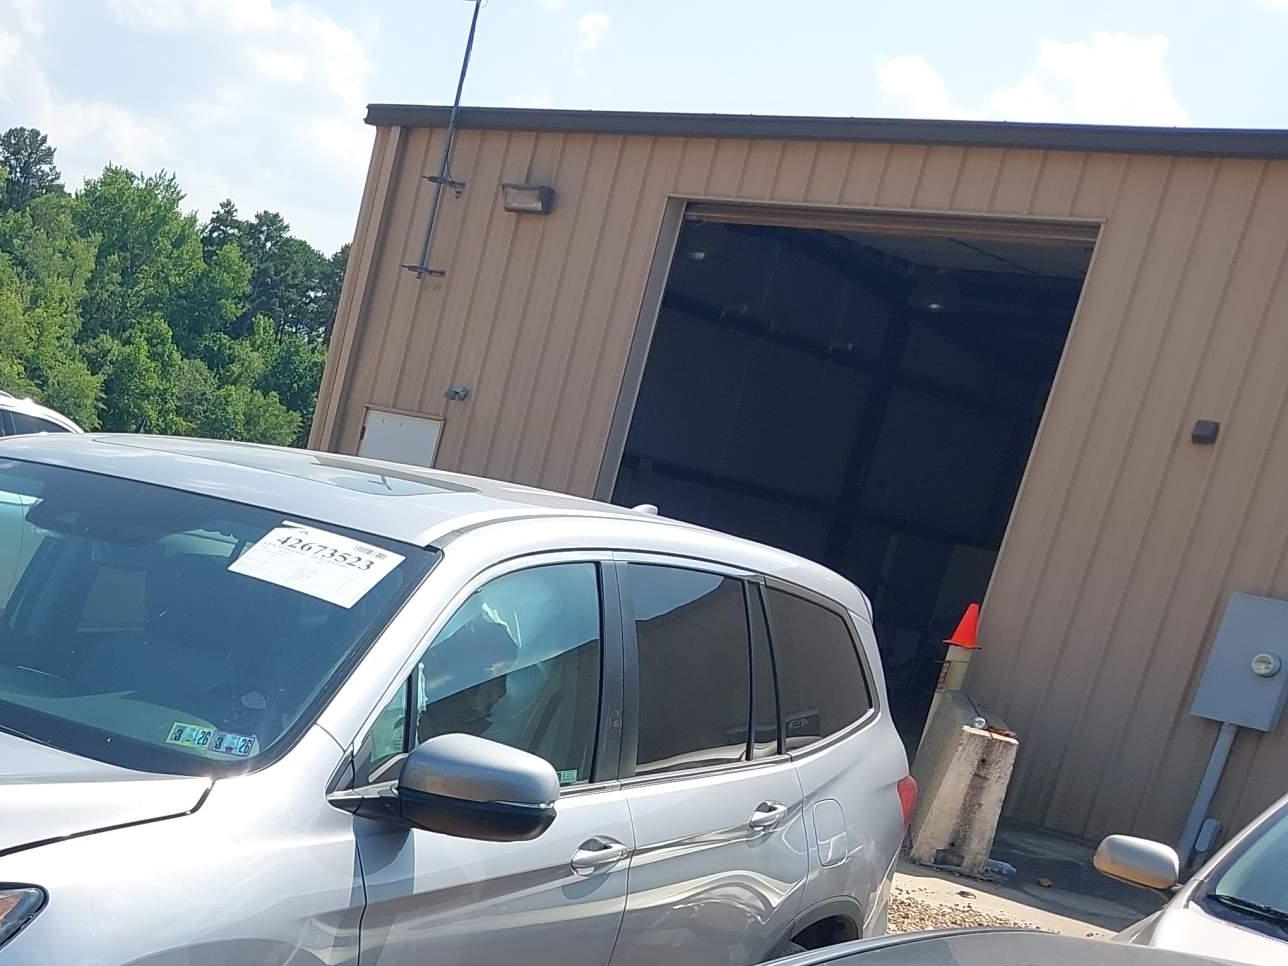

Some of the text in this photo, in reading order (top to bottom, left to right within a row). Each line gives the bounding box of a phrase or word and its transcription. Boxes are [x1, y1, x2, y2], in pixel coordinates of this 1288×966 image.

[276, 536, 375, 570] 42673523
[174, 728, 211, 746] 3 26
[215, 736, 252, 753] 3 26
